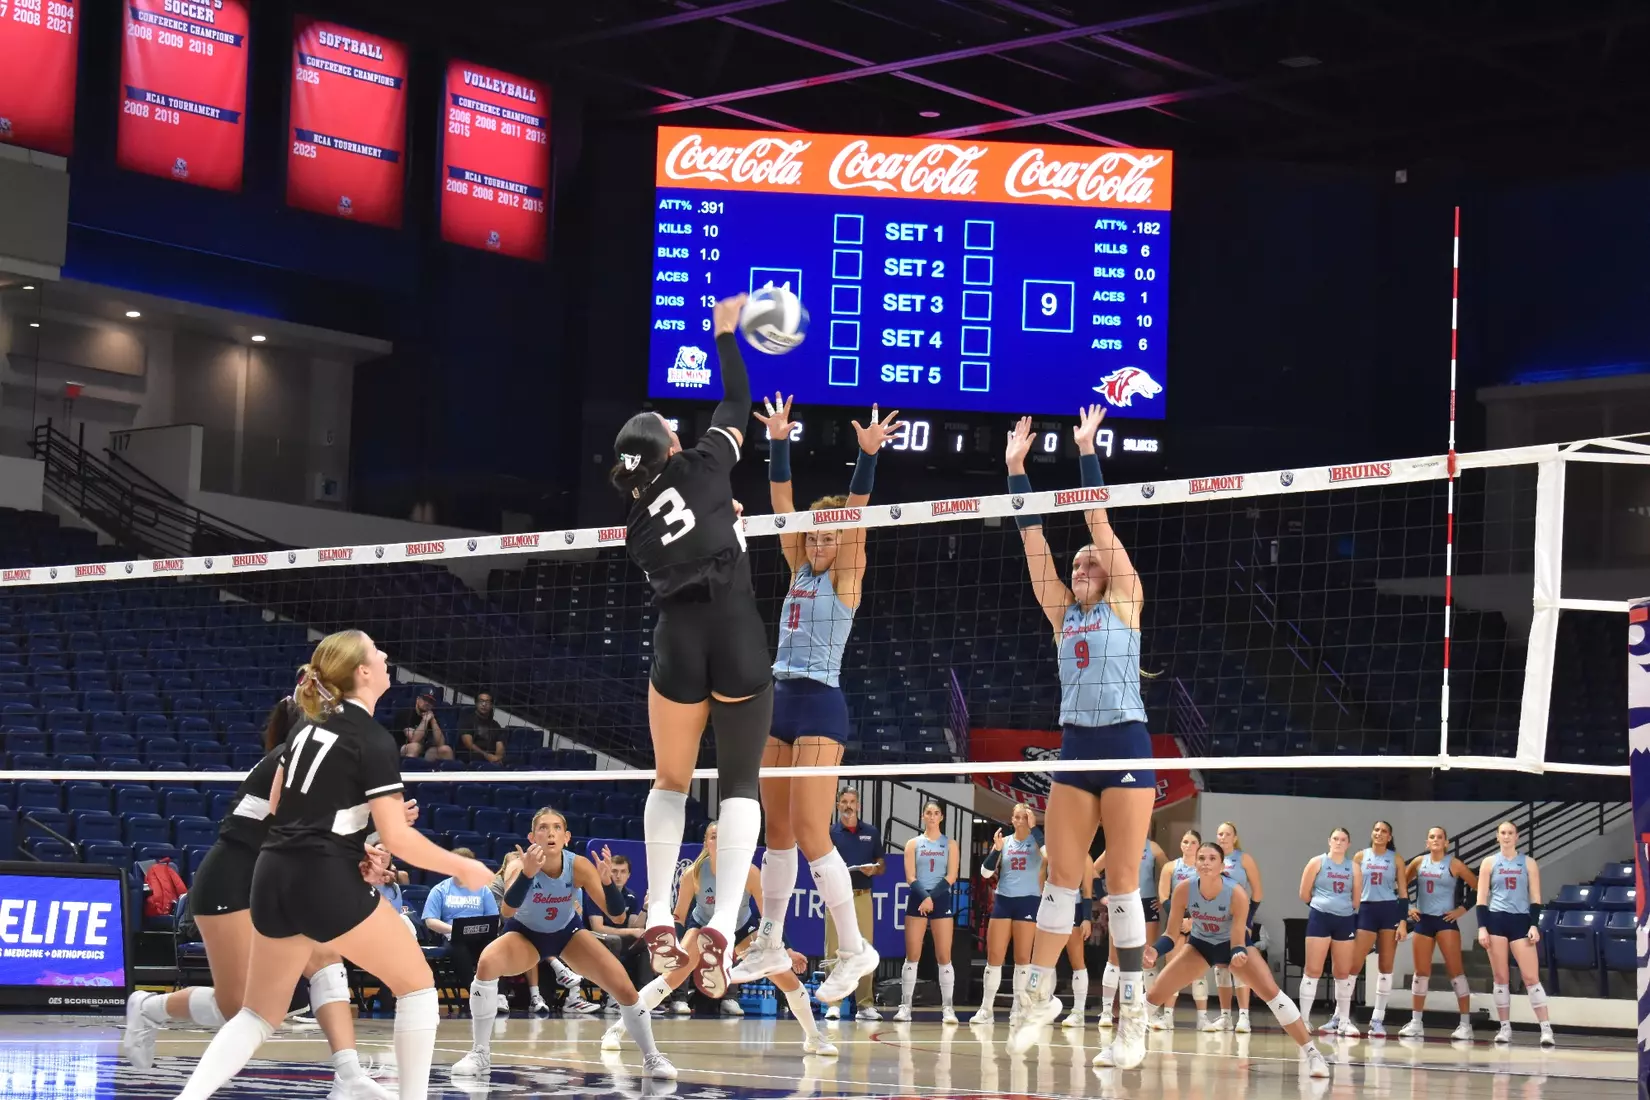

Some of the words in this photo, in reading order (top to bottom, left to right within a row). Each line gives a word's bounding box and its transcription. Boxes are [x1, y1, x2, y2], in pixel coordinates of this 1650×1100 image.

[48, 0, 74, 20] 2004
[164, 0, 215, 24] SOCCER
[13, 7, 41, 26] 2008
[47, 16, 72, 35] 2021
[138, 11, 188, 32] CONFERENCE
[190, 25, 234, 44] CHAMPIONS
[128, 23, 153, 41] 2008
[158, 31, 183, 48] 2009
[189, 39, 214, 56] 2019
[319, 31, 383, 60] SOFTBALL
[296, 68, 320, 85] 2025
[306, 56, 352, 76] CONFERENCE
[354, 68, 395, 87] CHAMPIONS
[463, 70, 537, 103] VOLLEYBALL
[124, 101, 149, 118] 2008
[155, 108, 180, 125] 2019
[146, 92, 166, 106] NCAA
[168, 97, 220, 119] TOURNAMENT
[458, 97, 501, 116] CONFERENCE
[502, 108, 540, 126] CHAMPIONS
[448, 121, 470, 137] 2015
[449, 108, 471, 124] 2006
[475, 115, 497, 131] 2008
[501, 122, 521, 138] 2011
[525, 128, 547, 145] 2012
[293, 142, 317, 159] 2025
[313, 133, 331, 147] NCAA
[334, 138, 382, 158] TOURNAMENT
[665, 134, 812, 185] Coca-Cola
[829, 140, 988, 195] Coca-Cola
[465, 171, 481, 184] NCAA
[484, 176, 528, 195] TOURNAMENT
[1004, 148, 1164, 203] Coca-Cola
[446, 179, 468, 195] 2006
[472, 186, 494, 201] 2008
[498, 192, 519, 207] 2012
[522, 198, 544, 213] 2015
[659, 199, 692, 211] ATT%
[697, 202, 724, 214] .391
[658, 223, 692, 235] KILLS
[703, 225, 718, 237] 10
[885, 222, 928, 241] SET
[934, 225, 943, 242] 1
[1095, 219, 1127, 231] ATT%
[1132, 222, 1160, 235] .182
[658, 247, 689, 258] BLKS
[700, 249, 720, 261] 1.0
[1095, 243, 1127, 254] KILLS
[1141, 245, 1150, 257] 6
[657, 271, 689, 282] ACES
[705, 272, 711, 284] 1
[884, 258, 927, 277] SET
[931, 261, 944, 278] 2
[1094, 267, 1125, 278] BLKS
[1135, 268, 1155, 281] 0.0
[655, 295, 685, 306] DIGS
[700, 296, 716, 308] 13
[883, 293, 926, 312] SET
[930, 296, 943, 313] 3
[1041, 293, 1057, 316] 9
[1093, 291, 1125, 302] ACES
[1141, 292, 1147, 303] 1
[654, 320, 685, 331] ASTS
[702, 319, 711, 331] 9
[1093, 315, 1121, 326] DIGS
[1136, 315, 1152, 327] 10
[882, 328, 924, 347] SET
[929, 331, 942, 348] 4
[1092, 339, 1122, 350] ASTS
[1138, 338, 1147, 350] 6
[881, 364, 923, 383] SET
[928, 367, 941, 384] 5
[1044, 432, 1057, 452] 0
[1096, 429, 1114, 457] 9
[3, 569, 31, 581] BELMONT
[75, 564, 106, 577] BRUINS
[153, 559, 184, 571] BELMONT
[232, 553, 268, 567] BRUINS
[318, 548, 353, 561] BELMONT
[406, 541, 445, 556] BRUINS
[501, 534, 540, 549] BELMONT
[599, 528, 627, 542] BRUI
[813, 508, 861, 525] BRUINS
[932, 499, 980, 516] BELMONT
[1055, 487, 1110, 506] BRUINS
[1189, 476, 1244, 495] BELMONT
[1329, 462, 1392, 483] BRUINS
[648, 487, 696, 546] 3
[788, 603, 800, 630] 11
[1074, 641, 1089, 669] 9
[284, 724, 339, 794] 17
[929, 859, 935, 872] 1
[1010, 857, 1027, 870] 22
[1332, 881, 1345, 893] 13
[1370, 872, 1383, 885] 21
[1426, 880, 1434, 894] 0
[1504, 877, 1517, 890] 15
[533, 892, 573, 903] Belmont
[0, 899, 112, 945] ELITE
[545, 907, 558, 920] 3
[1192, 911, 1227, 922] Belmont
[1202, 922, 1220, 933] 10
[4, 948, 43, 958] MEDICINE
[51, 949, 105, 960] ORTHOPEDICS
